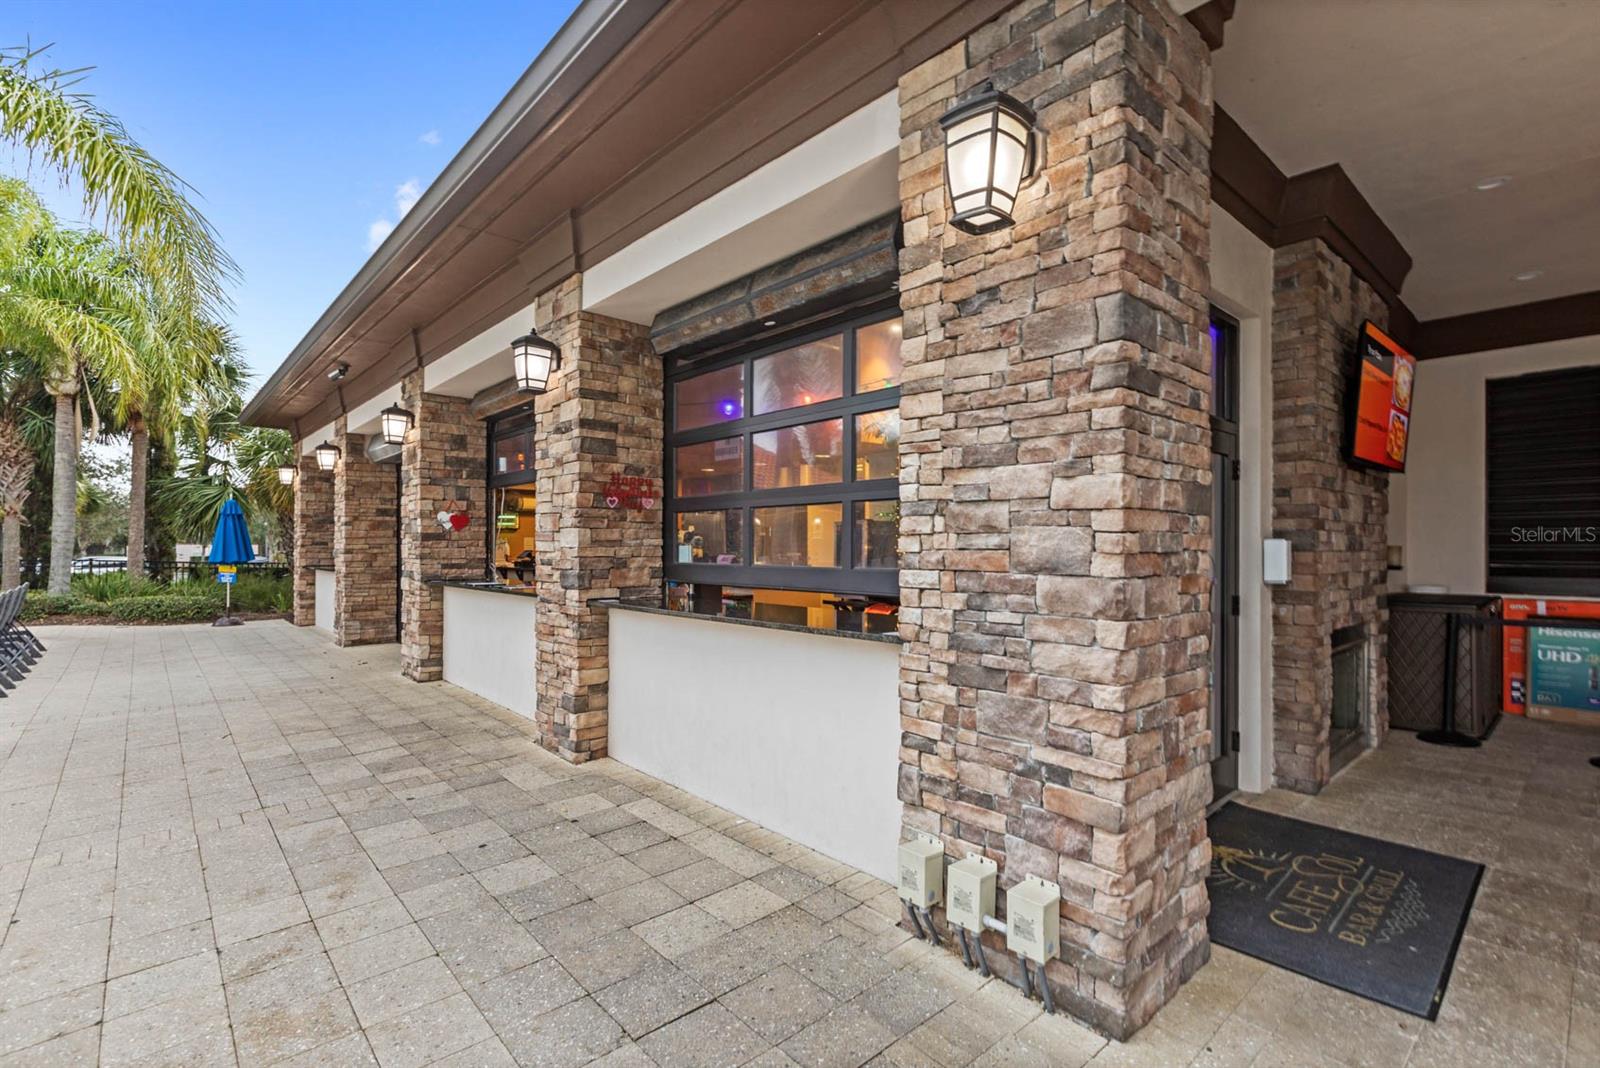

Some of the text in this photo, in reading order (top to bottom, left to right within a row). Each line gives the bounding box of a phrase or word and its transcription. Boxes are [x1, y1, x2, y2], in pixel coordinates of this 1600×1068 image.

[1537, 649, 1581, 663] UHD
[1269, 880, 1341, 933] CAFE
[1338, 912, 1378, 947] BAR
[1365, 868, 1405, 901] GRILL
